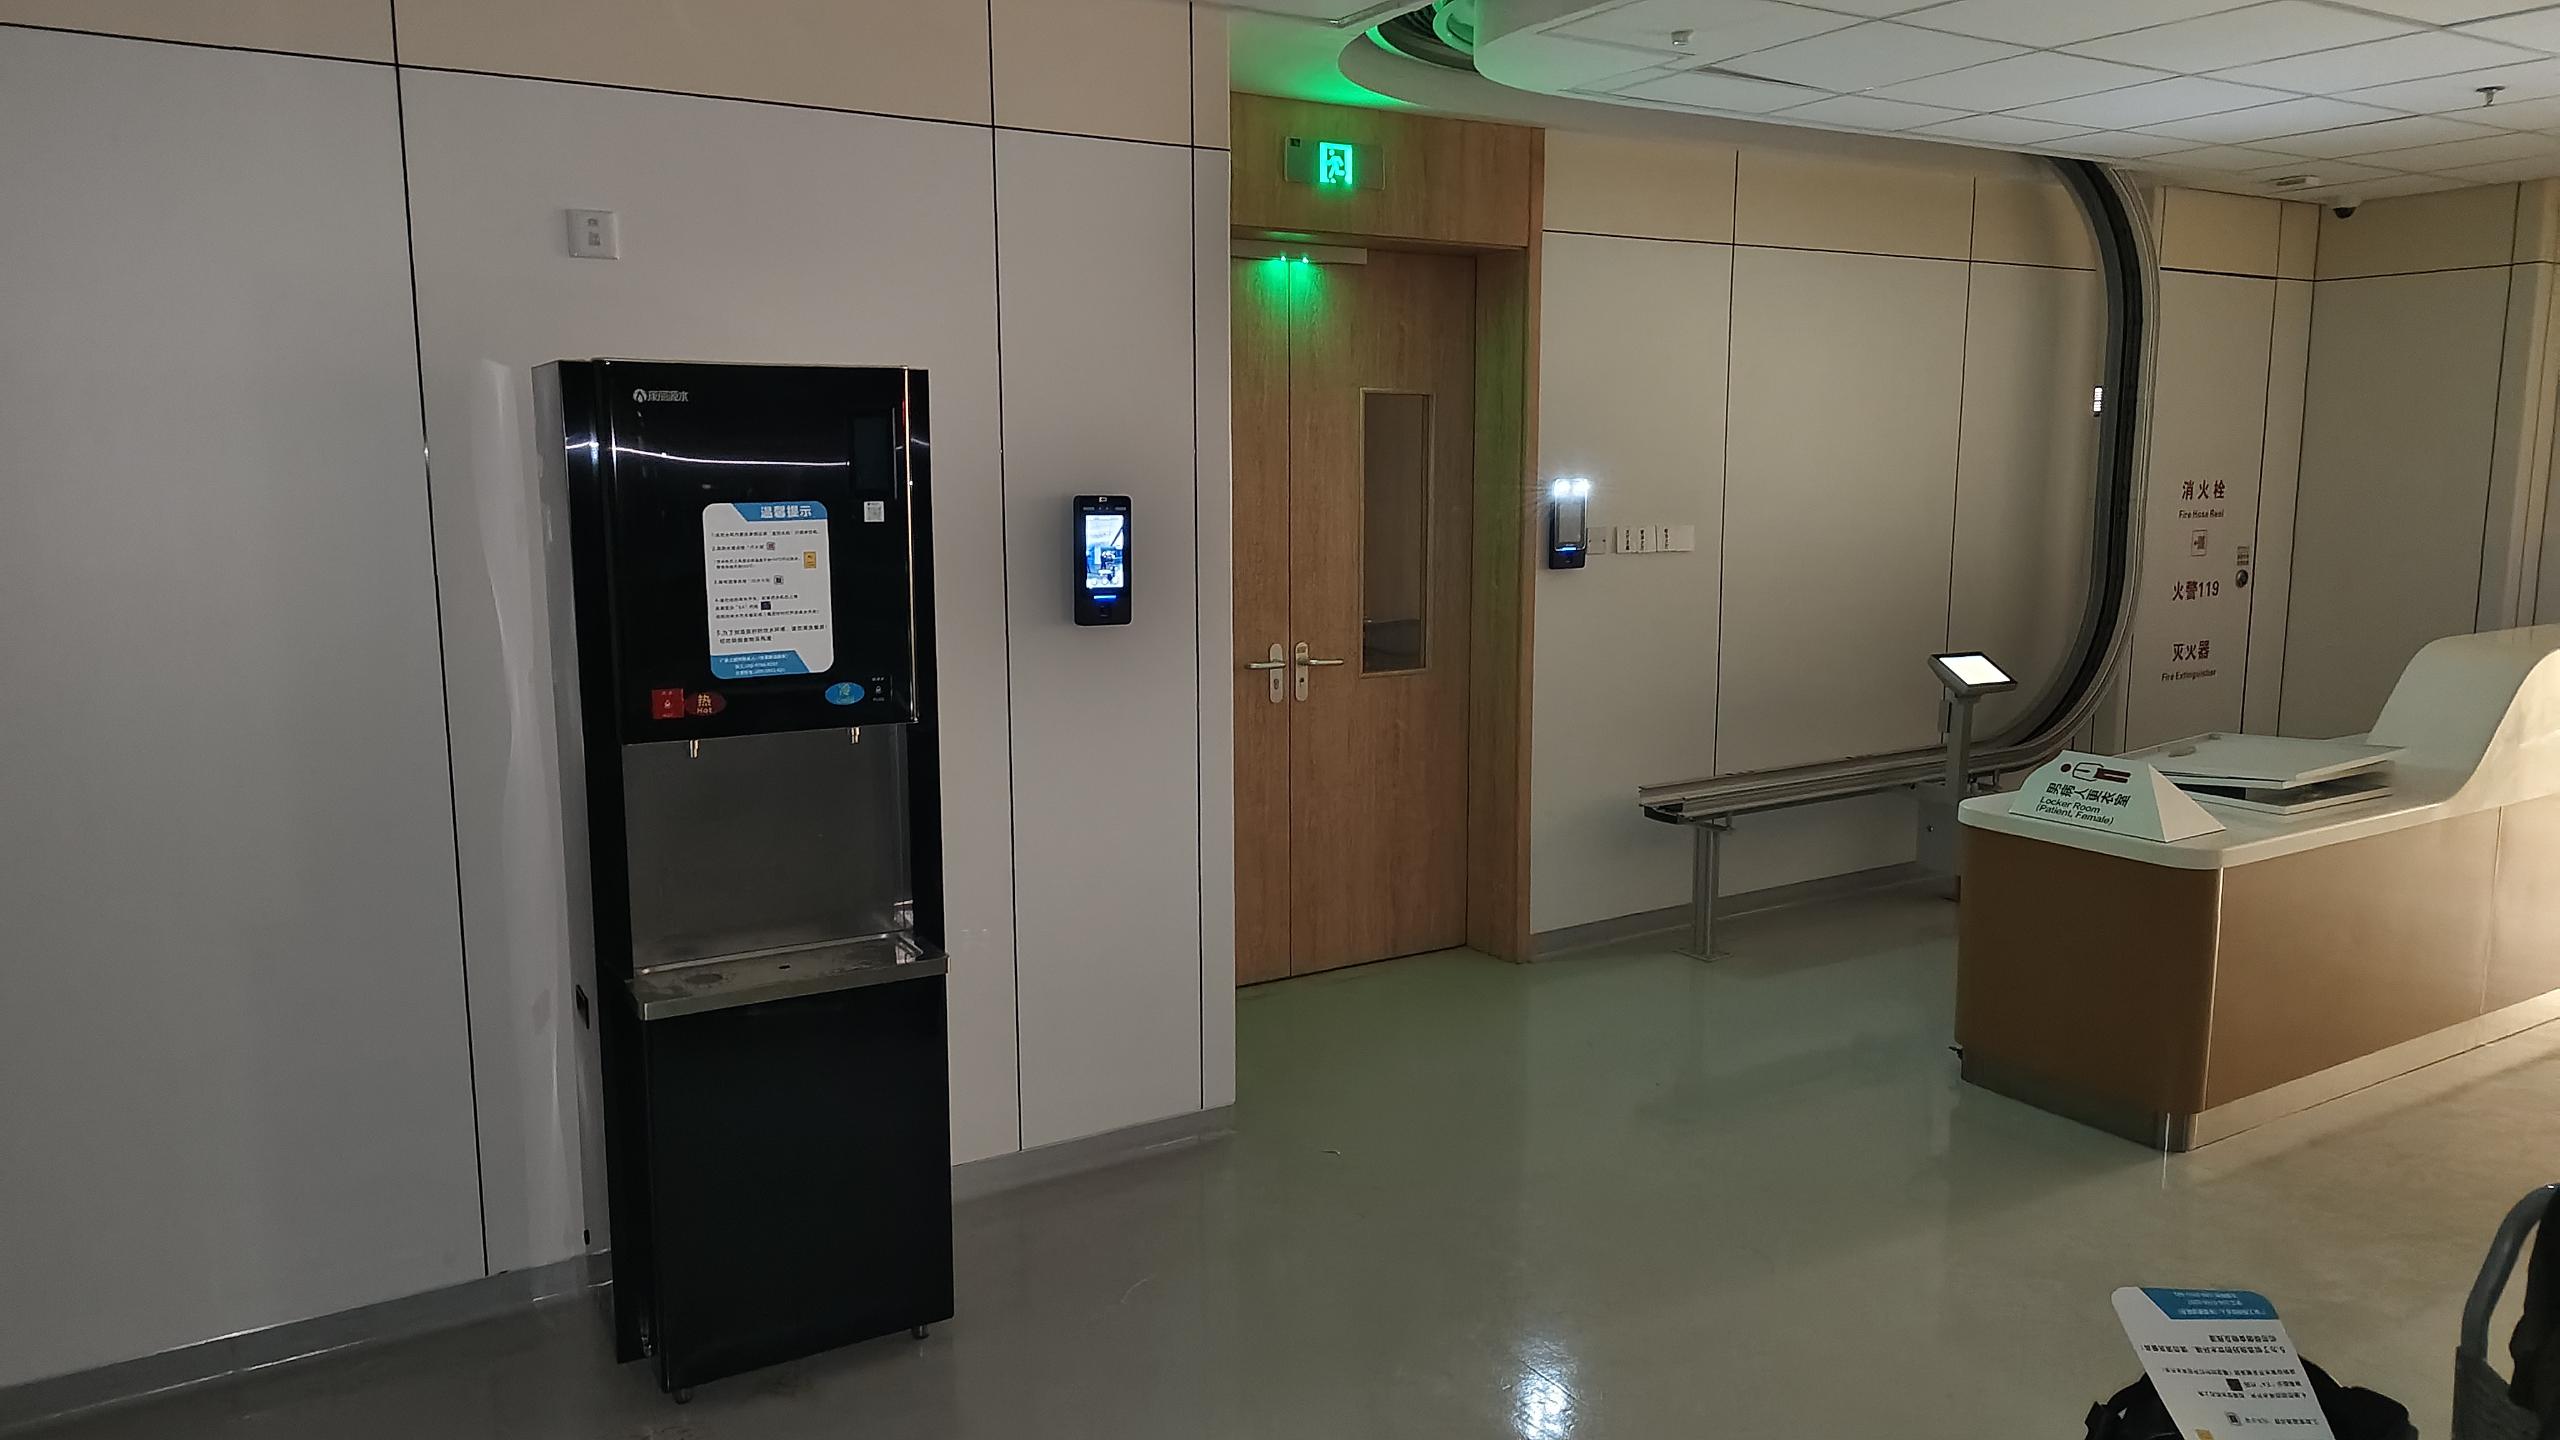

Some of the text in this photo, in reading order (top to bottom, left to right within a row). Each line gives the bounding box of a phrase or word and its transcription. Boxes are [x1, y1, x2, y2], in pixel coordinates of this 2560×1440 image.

[2181, 479, 2226, 501] 消火栓
[760, 505, 812, 519] 温馨提示
[2178, 509, 2192, 519] Fire
[2193, 509, 2209, 519] Hose
[2172, 580, 2220, 601] 火警119
[2172, 639, 2210, 662] 灭火器
[2160, 672, 2174, 682] Fire
[697, 693, 712, 707] 热
[2046, 782, 2131, 808] 男病人更衣室
[2039, 796, 2101, 814] Locker Room
[2035, 804, 2114, 826] (Patient, Female)
